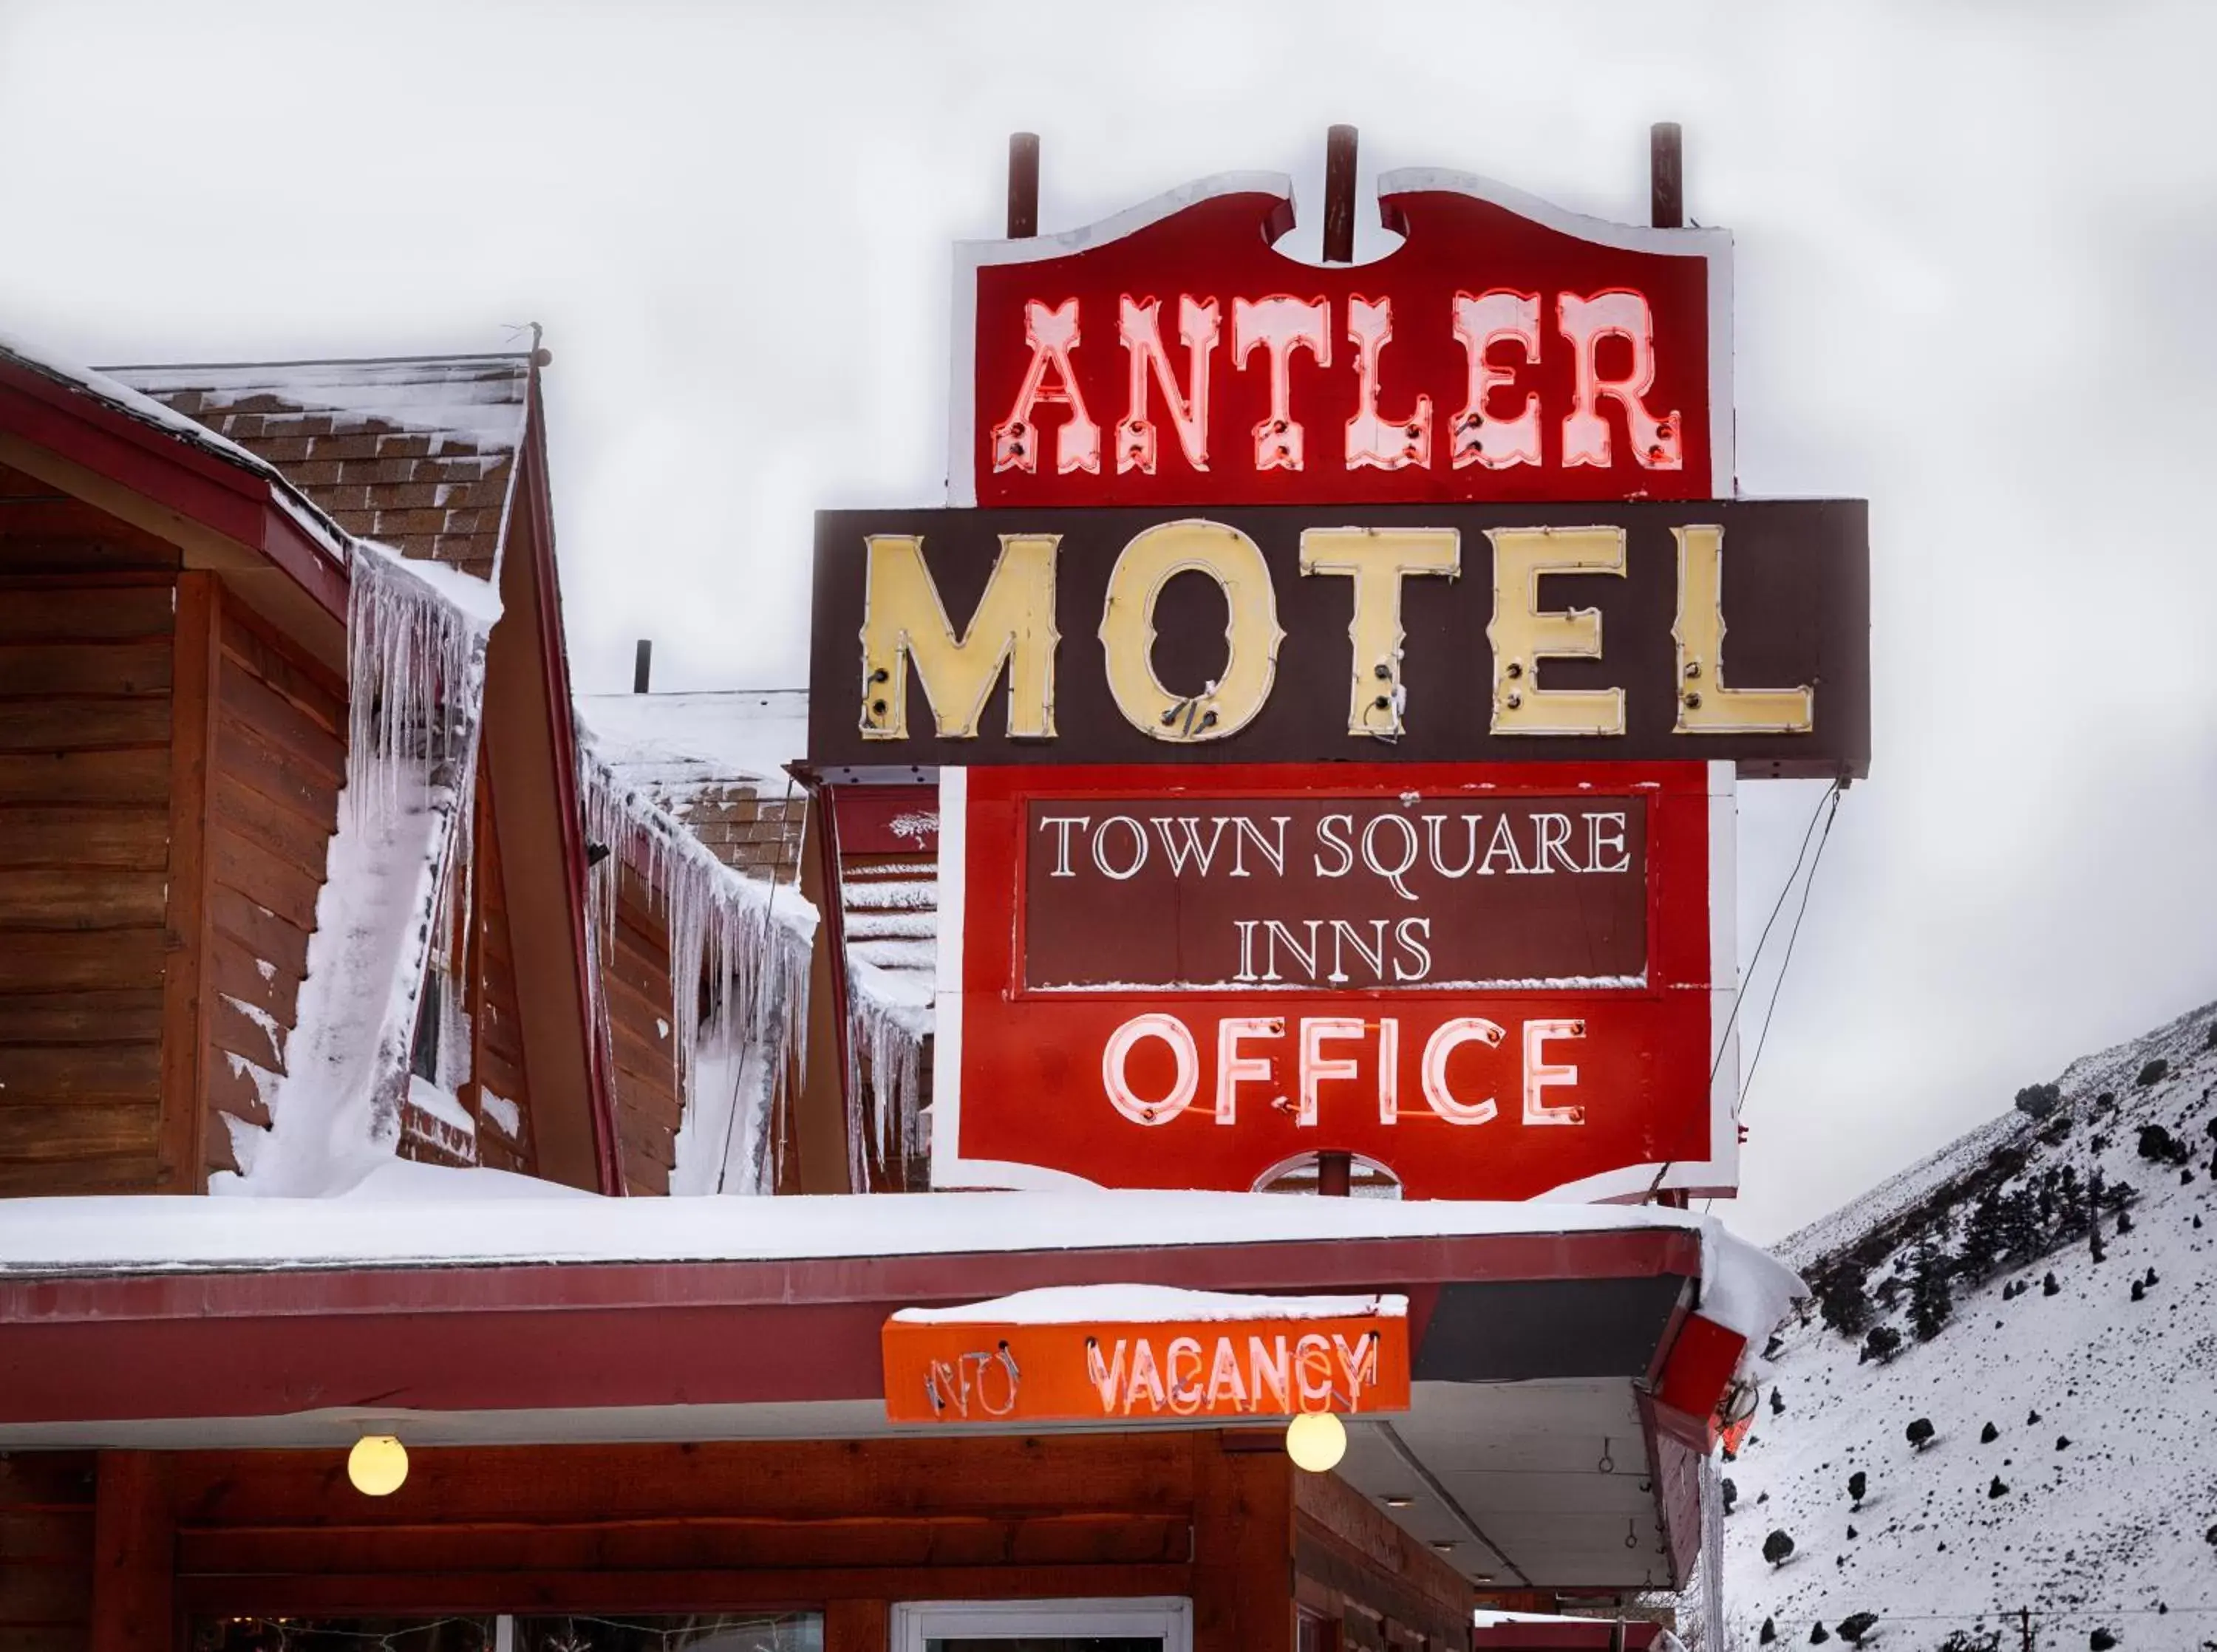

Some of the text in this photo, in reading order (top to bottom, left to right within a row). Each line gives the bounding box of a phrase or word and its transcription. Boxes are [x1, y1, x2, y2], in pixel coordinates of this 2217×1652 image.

[992, 288, 1682, 474] ANTLER
[860, 519, 1816, 742] MOTEL
[1040, 813, 1631, 900] TOWN SQUARE
[1233, 917, 1431, 983] INNS
[1102, 1013, 1586, 1125] OFFICE
[925, 1333, 1380, 1417] NO VACANCY
